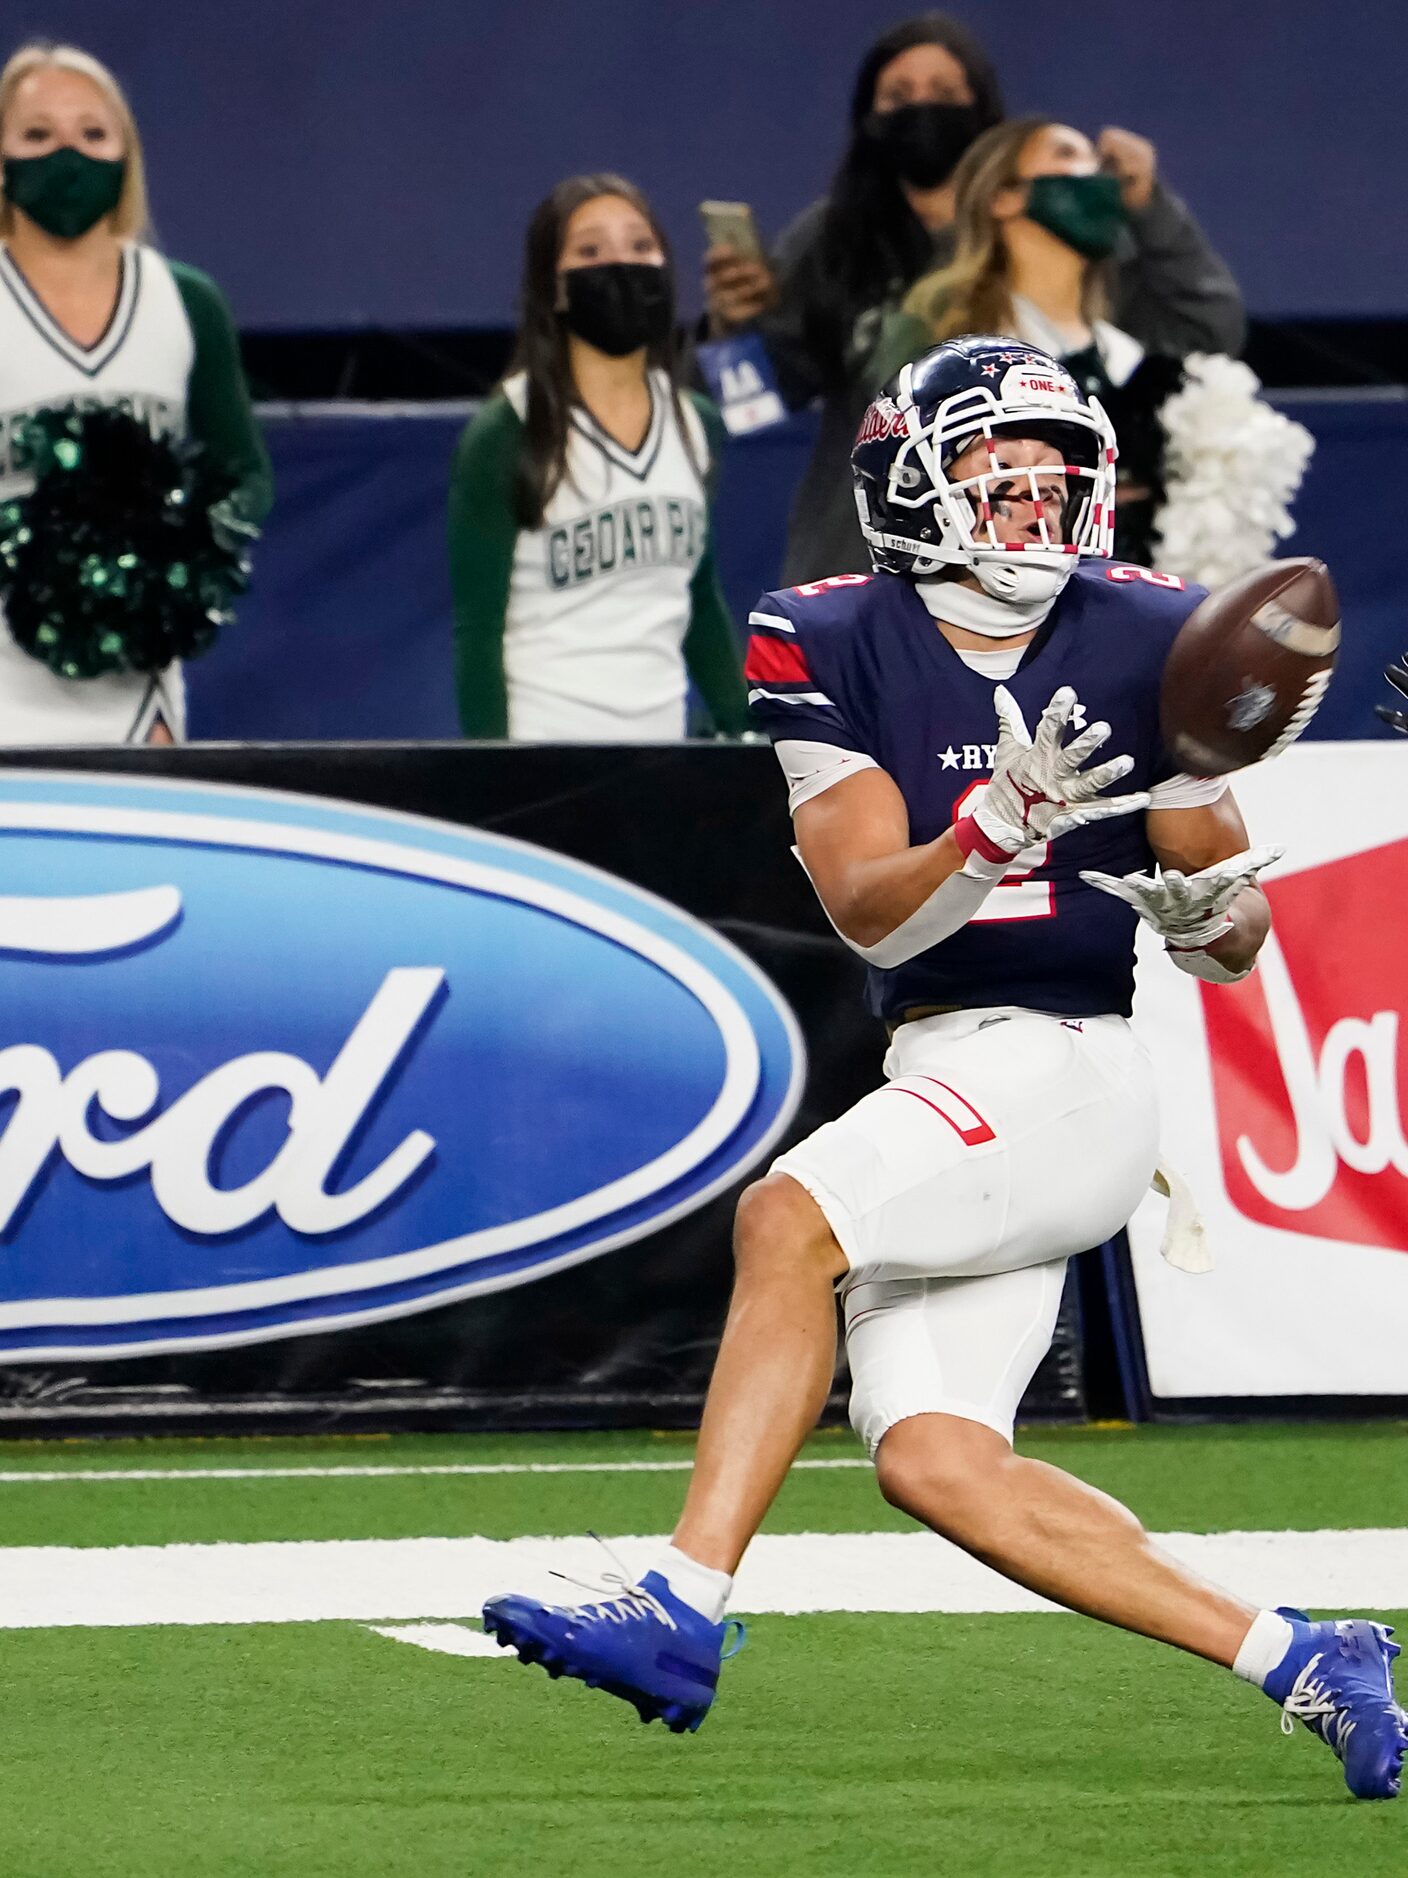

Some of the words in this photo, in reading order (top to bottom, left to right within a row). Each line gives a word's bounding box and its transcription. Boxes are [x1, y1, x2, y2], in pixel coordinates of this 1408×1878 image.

[1028, 379, 1056, 393] ONE
[547, 499, 657, 589] CEDAR
[1105, 565, 1185, 591] 2
[962, 744, 997, 770] RY
